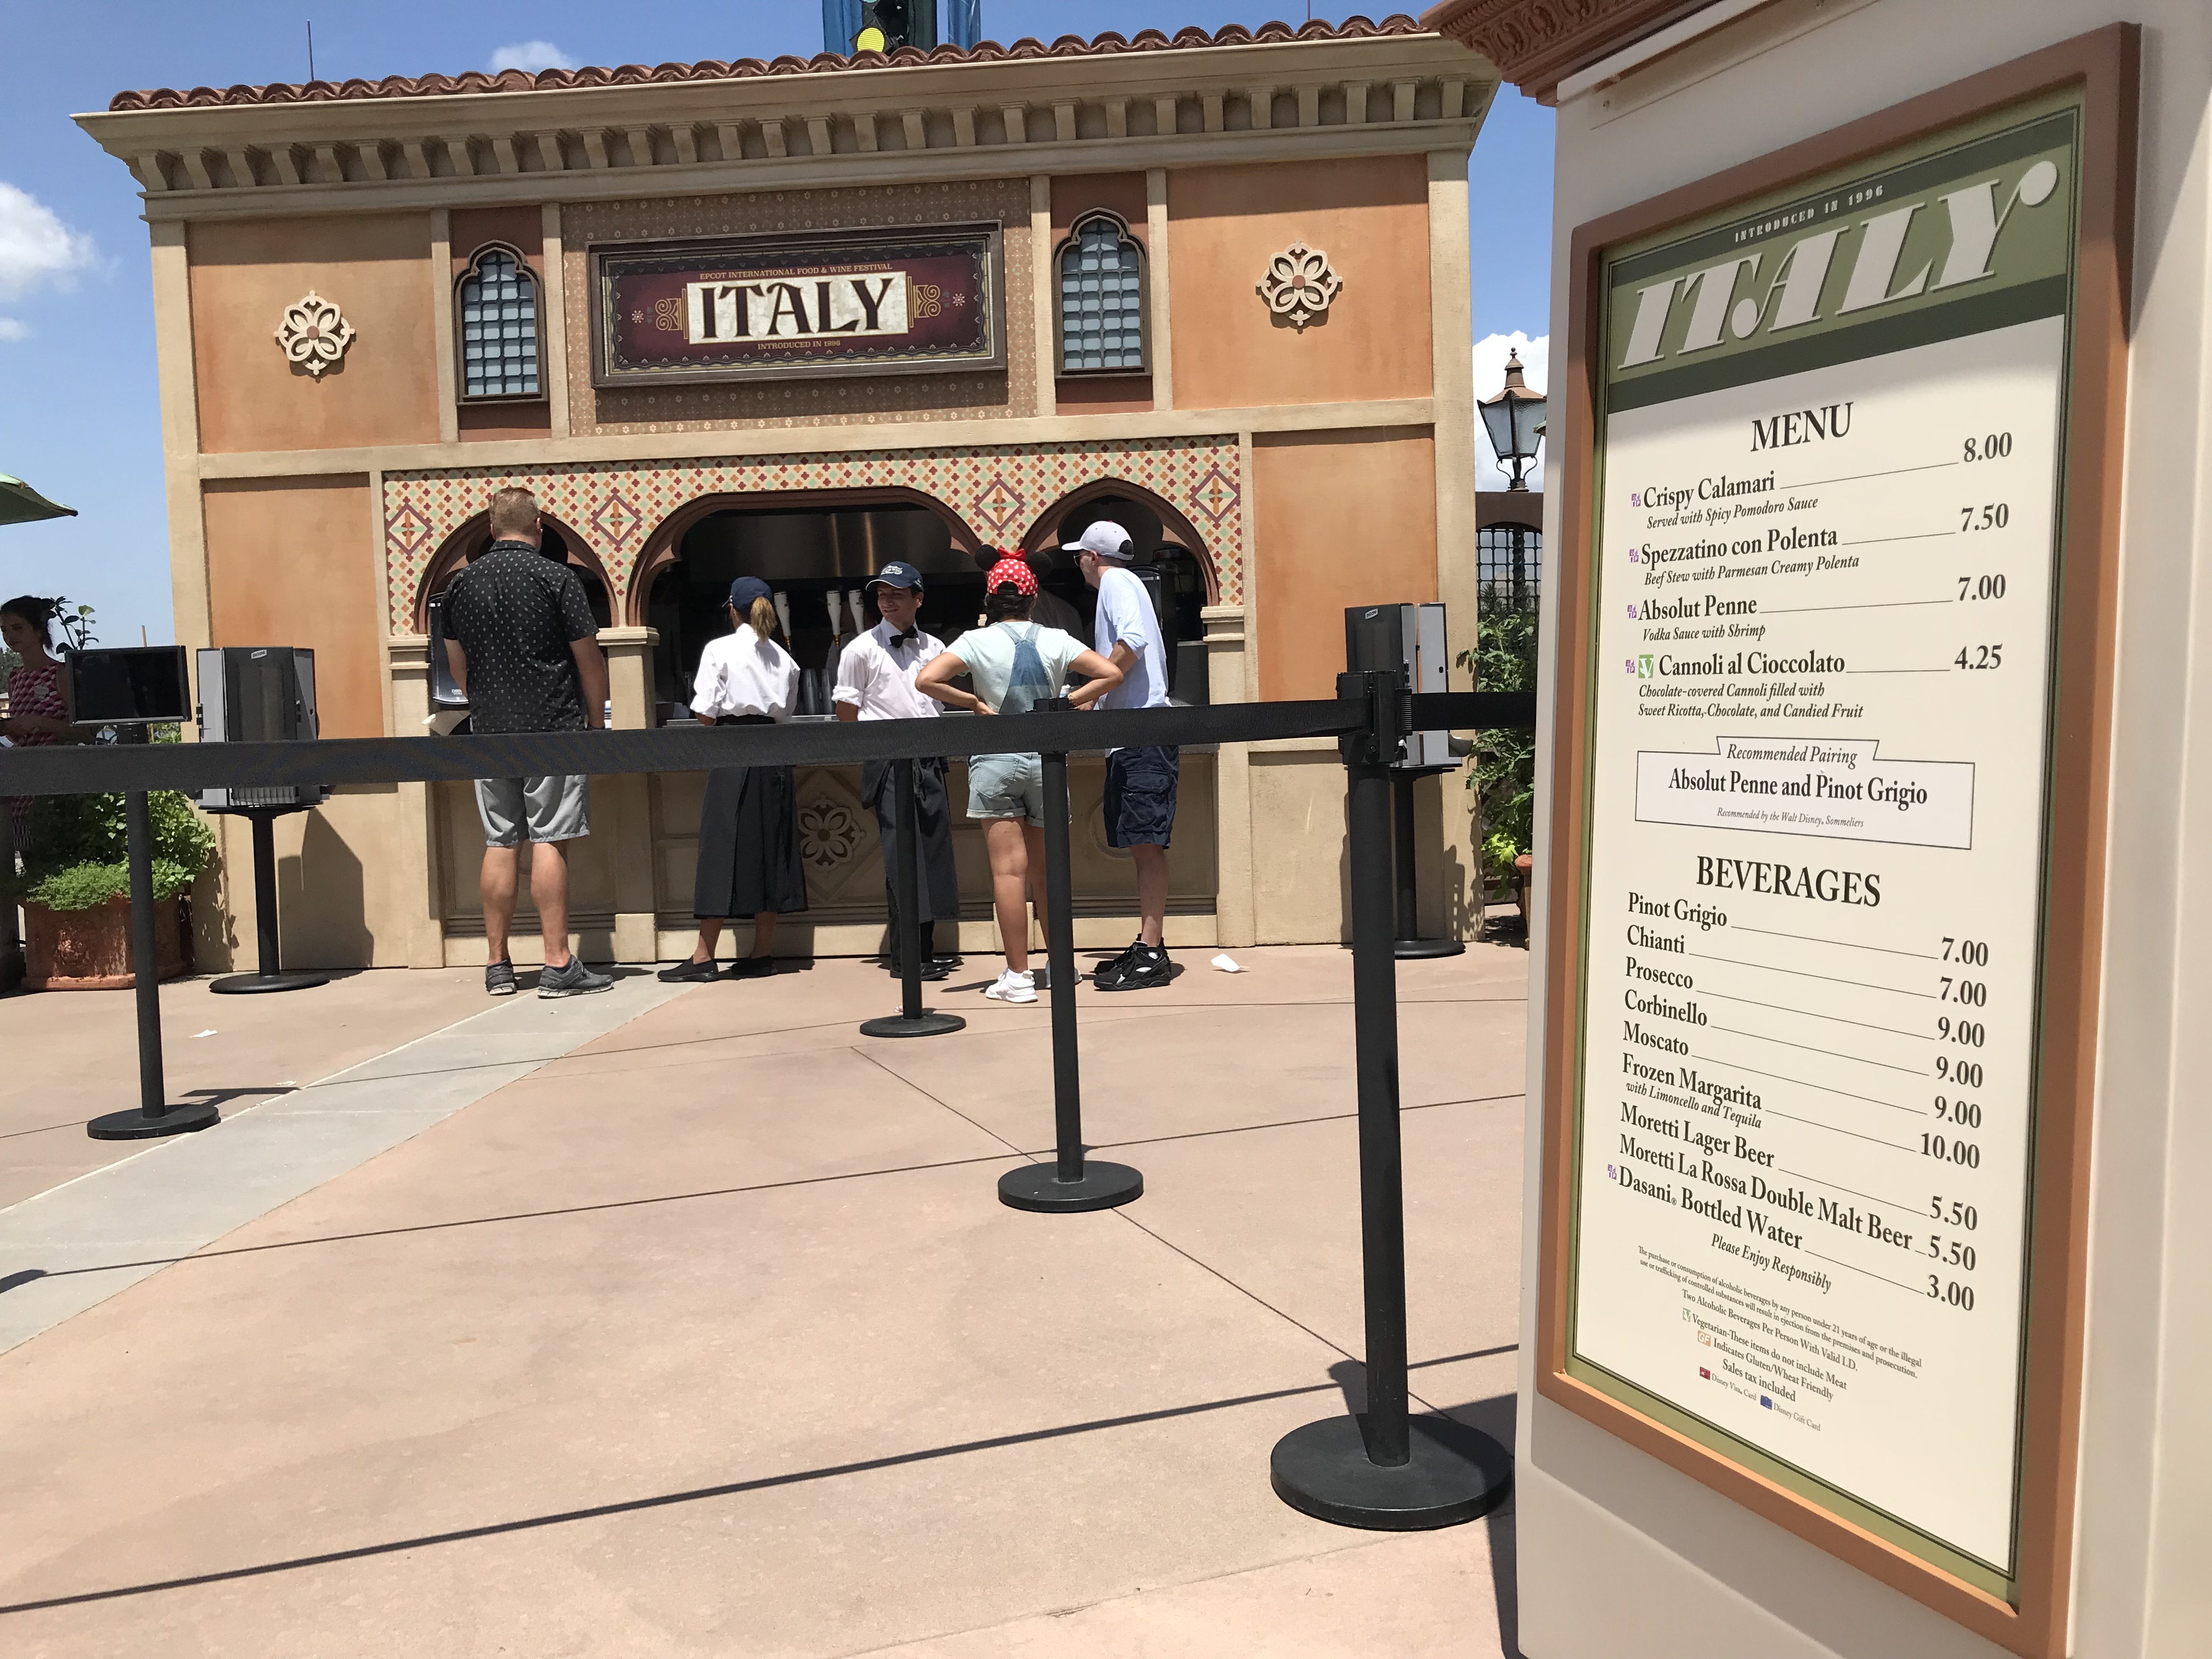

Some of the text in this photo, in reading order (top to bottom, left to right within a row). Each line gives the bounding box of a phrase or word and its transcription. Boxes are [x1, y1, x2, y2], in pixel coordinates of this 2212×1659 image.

[1735, 185, 1883, 242] INTRODUCED IN 1996
[729, 268, 795, 278] INTERNATIONAL
[798, 266, 819, 274] FOOD
[854, 263, 893, 272] FESTIVAL
[1618, 160, 2059, 369] ITALY
[699, 277, 895, 340] ITALY
[758, 341, 811, 349] INTRODUCED
[1751, 402, 1853, 452] MENU
[1644, 432, 2012, 511] Crispy Calamari 8.00
[1641, 504, 2008, 571] Spezzatino con Polenta 7.50
[1647, 497, 1818, 529] Served with Spicy Pomodoro Sauce
[1638, 574, 2006, 620] Absolut Penne 7.00
[1644, 555, 1859, 589] Beef Stew with Parmesan Creamy Polenta
[1644, 624, 1765, 641] Vodka Sauce with Shrimp
[1660, 644, 2002, 675] Cannoli al Cioccolato 4.25
[1639, 682, 1824, 701] Chocolate-covered Cannoli filled with
[1639, 703, 1863, 719] Sweet Ricotta, Chocolate, and Candied Fruit
[1727, 744, 1858, 770] Recommended Pairing
[1668, 768, 1927, 811] Absolut Penne and Pinot Grigio
[1696, 856, 1880, 907] BEVERAGES
[1628, 892, 1988, 966] Pinot Grigio 7.00
[1628, 925, 1987, 1007] Chianti 7.00
[1626, 956, 1984, 1047] Prosecco 9.00
[1625, 989, 1983, 1088] Corbinello 9.00
[1623, 1020, 1981, 1128] Moscato 9.00
[1626, 1082, 1761, 1128] with Limoncello and Tequila
[1623, 1053, 1979, 1169] Frozen Margarita 10.00
[1621, 1102, 1977, 1230] Moretti Lager Beer 5.50
[1620, 1133, 1976, 1271] Moretti La Rossa Double Malt Beer 5.50
[1681, 1187, 1741, 1228] Bottled
[1746, 1209, 1802, 1249] Water
[1927, 1274, 1974, 1311] 3.00
[1712, 1233, 1831, 1294] Please Enjoy Responsibly
[1638, 1246, 1647, 1256] The
[1648, 1252, 1670, 1265] purchase
[1677, 1265, 1711, 1282] consumption
[1719, 1279, 1742, 1294] alcoholic
[1744, 1288, 1770, 1306] beverages
[1772, 1300, 1779, 1311] by
[1780, 1306, 1790, 1315] any
[1791, 1310, 1811, 1322] person
[1813, 1318, 1831, 1330] under
[1832, 1324, 1839, 1334] 21
[1841, 1330, 1858, 1341] years
[1867, 1341, 1878, 1350] age
[1889, 1347, 1899, 1358] the
[1901, 1352, 1921, 1367] illegal
[1656, 1266, 1681, 1282] trafficking
[1688, 1280, 1714, 1294] controlled
[1716, 1290, 1744, 1306] substances
[1745, 1302, 1755, 1311] will
[1757, 1307, 1772, 1318] result
[1773, 1312, 1779, 1321] in
[1781, 1317, 1804, 1331] ejection
[1805, 1325, 1820, 1338] from
[1821, 1333, 1831, 1342] the
[1833, 1339, 1860, 1355] premises
[1862, 1351, 1874, 1360] and
[1876, 1357, 1917, 1379] prosecution.
[1682, 1289, 1857, 1371] Two Alcoholic Beverages Per Person With Valid I.D.
[1692, 1313, 1847, 1390] Vegetarian-These items do not include Meat
[1714, 1338, 1833, 1402] Indicates Gluten/Wheat Friendly
[1723, 1358, 1796, 1402] Sales tax included
